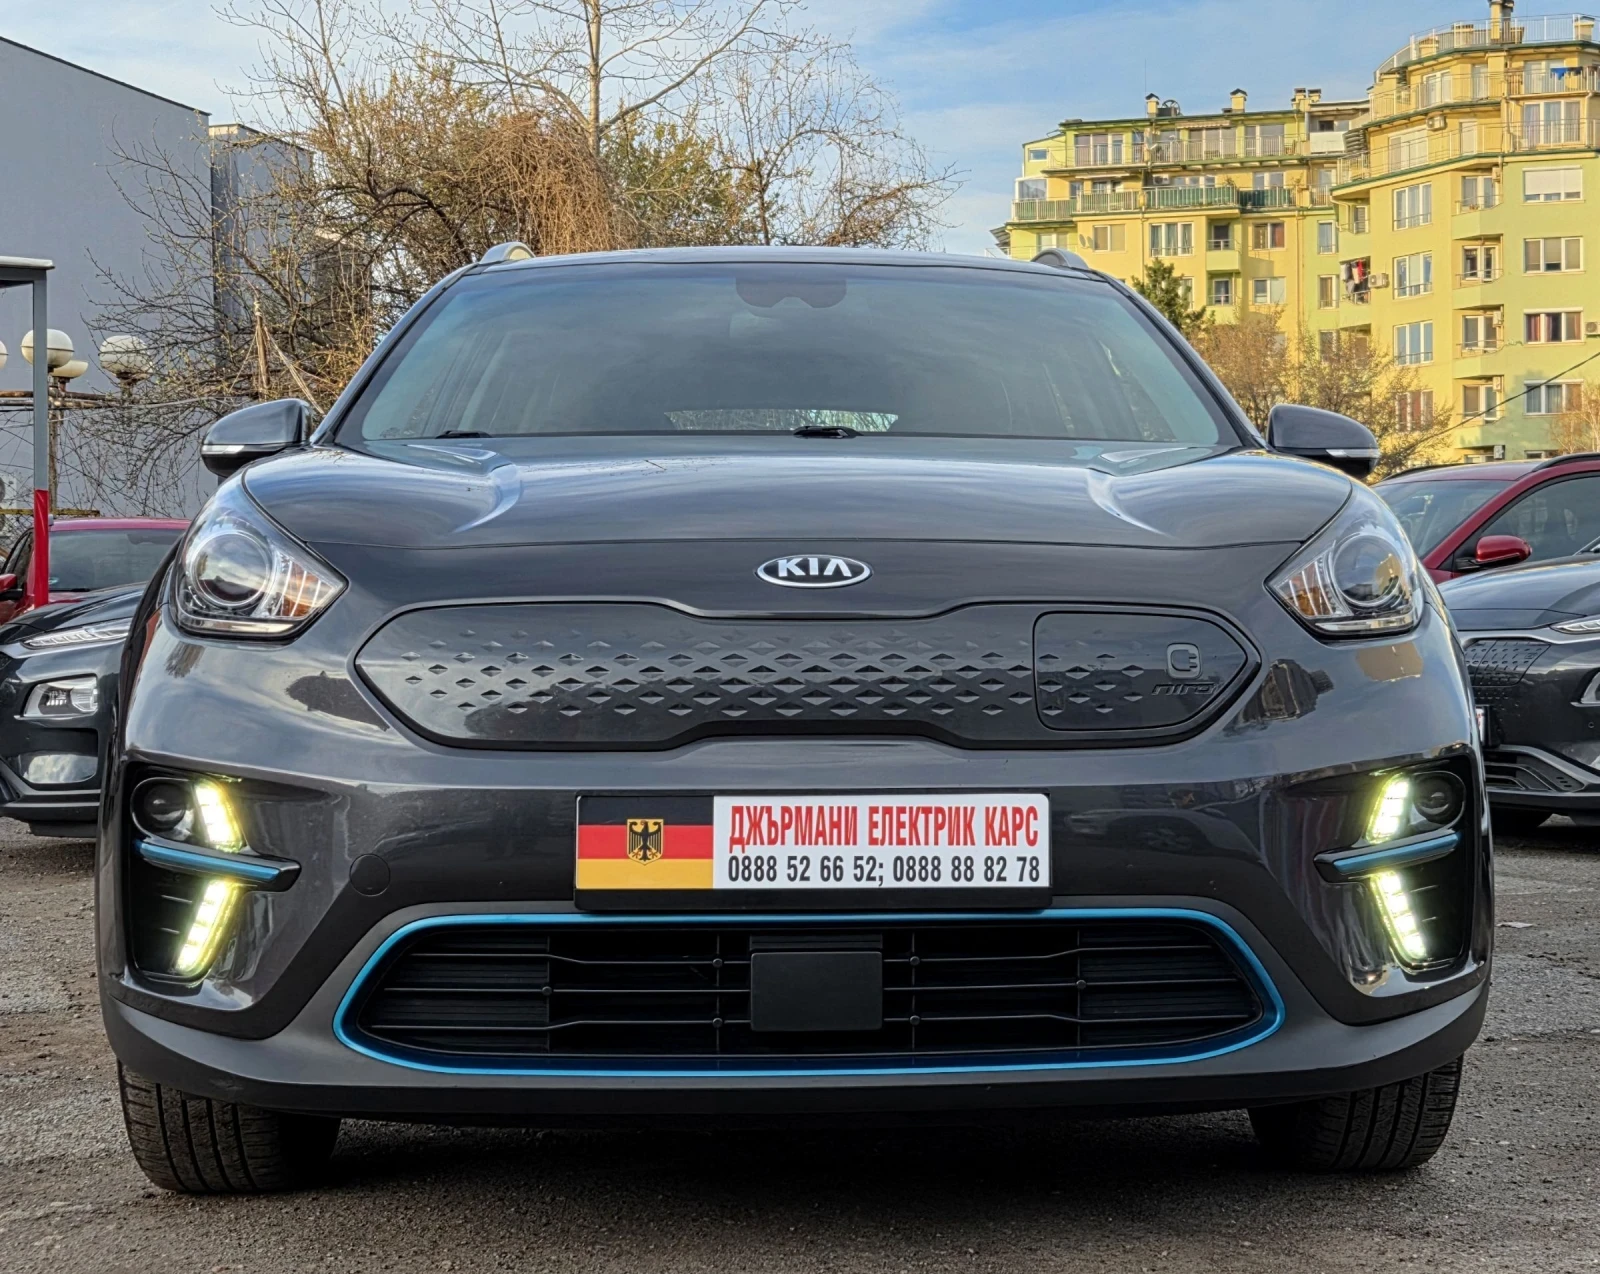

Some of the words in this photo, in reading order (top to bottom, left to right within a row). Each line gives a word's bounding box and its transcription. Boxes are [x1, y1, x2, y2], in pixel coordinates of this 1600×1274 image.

[777, 558, 853, 577] KIA
[729, 805, 858, 853] ДЖЪРМАНИ
[868, 805, 975, 846] ЕЛЕКТРИК
[984, 805, 1038, 846] КАРС
[728, 856, 777, 882] 0888
[786, 856, 811, 882] 52
[819, 856, 844, 882] 66
[853, 855, 884, 886] 52;
[892, 855, 941, 882] 0888
[950, 855, 975, 882] 88
[983, 855, 1008, 882] 82
[1016, 855, 1040, 882] 78
